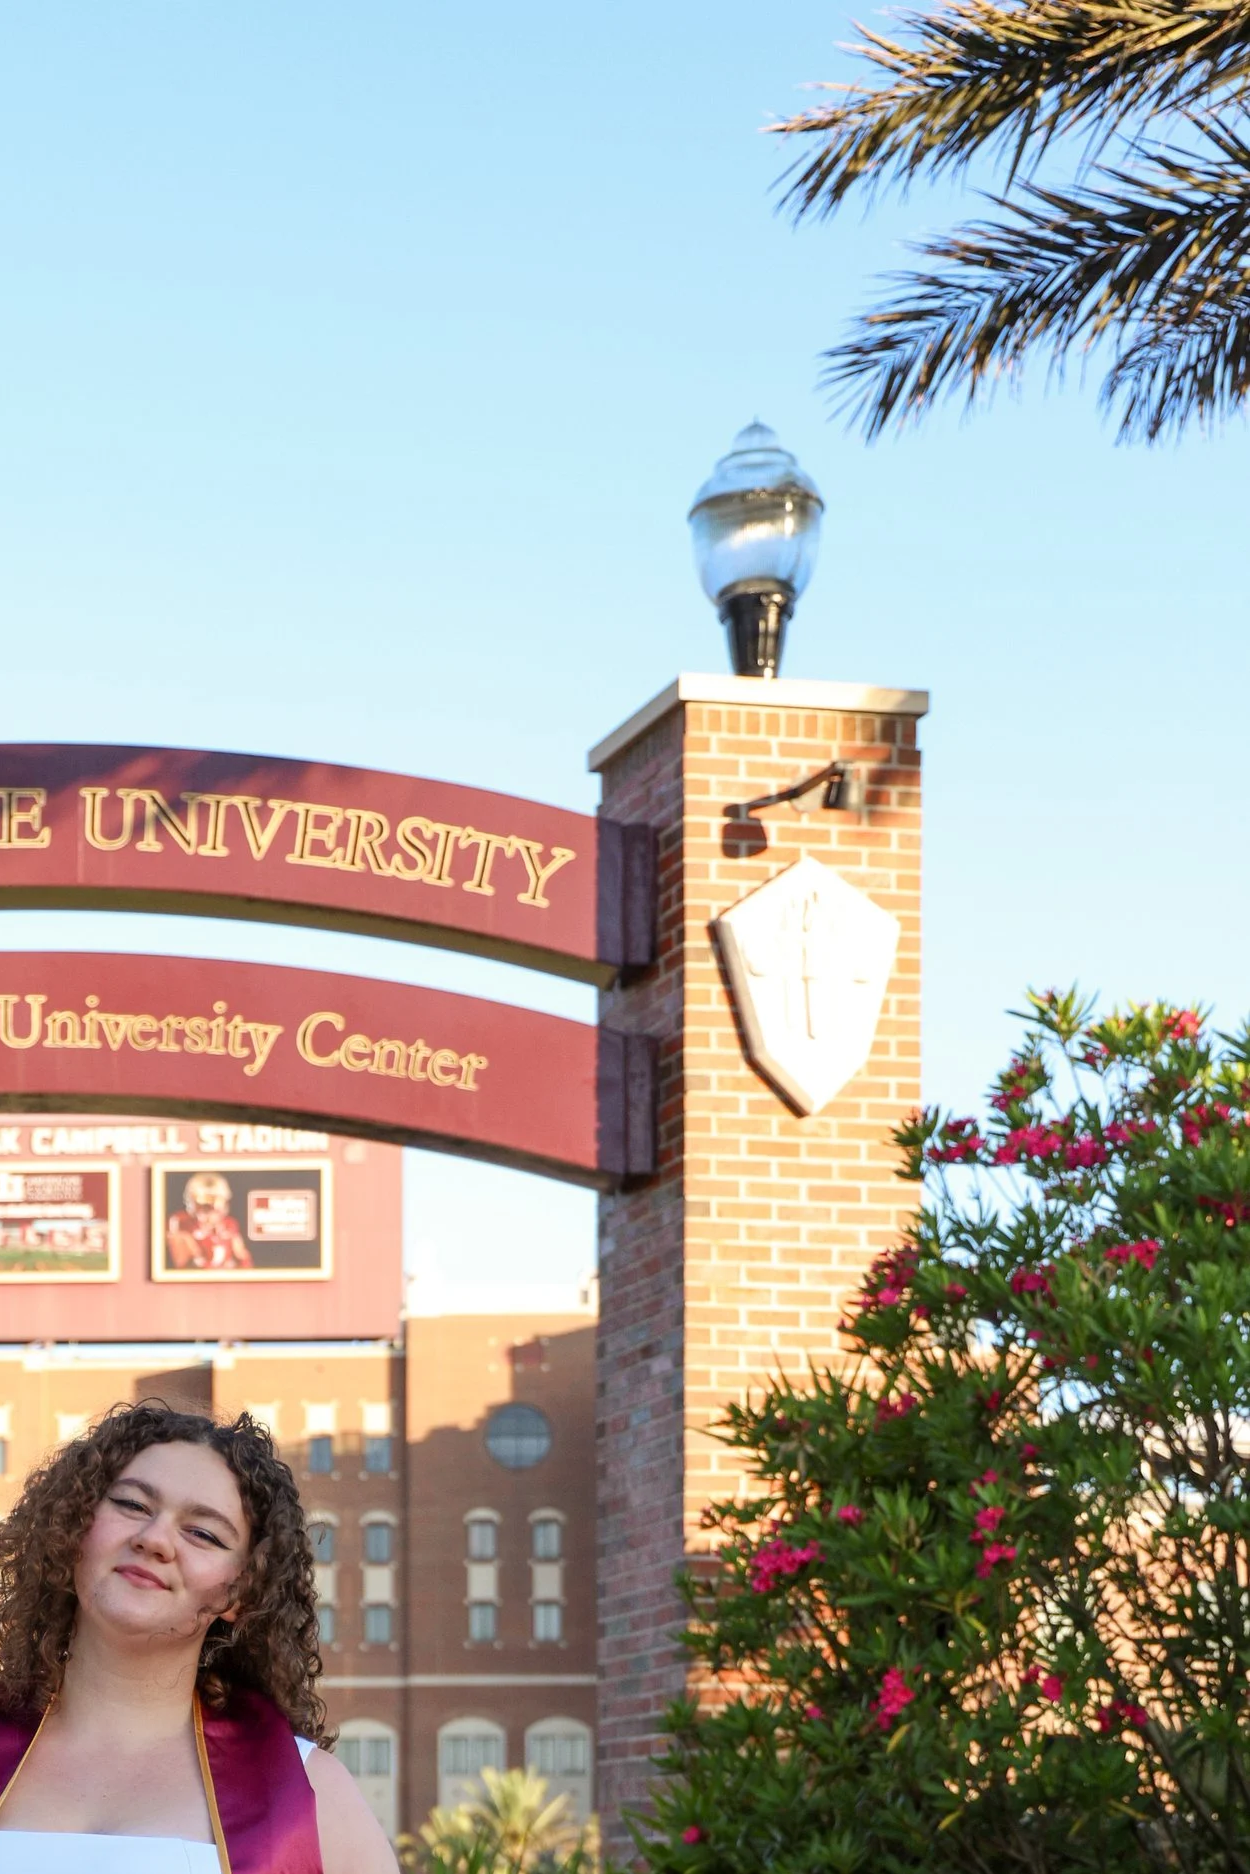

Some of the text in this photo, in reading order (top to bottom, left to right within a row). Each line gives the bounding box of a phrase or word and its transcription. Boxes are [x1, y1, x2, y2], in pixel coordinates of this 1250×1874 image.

[81, 786, 580, 909] UNIVERSITY
[296, 1010, 490, 1093] Center
[31, 1126, 186, 1156] CAMPBELL
[198, 1125, 329, 1153] STADIUM
